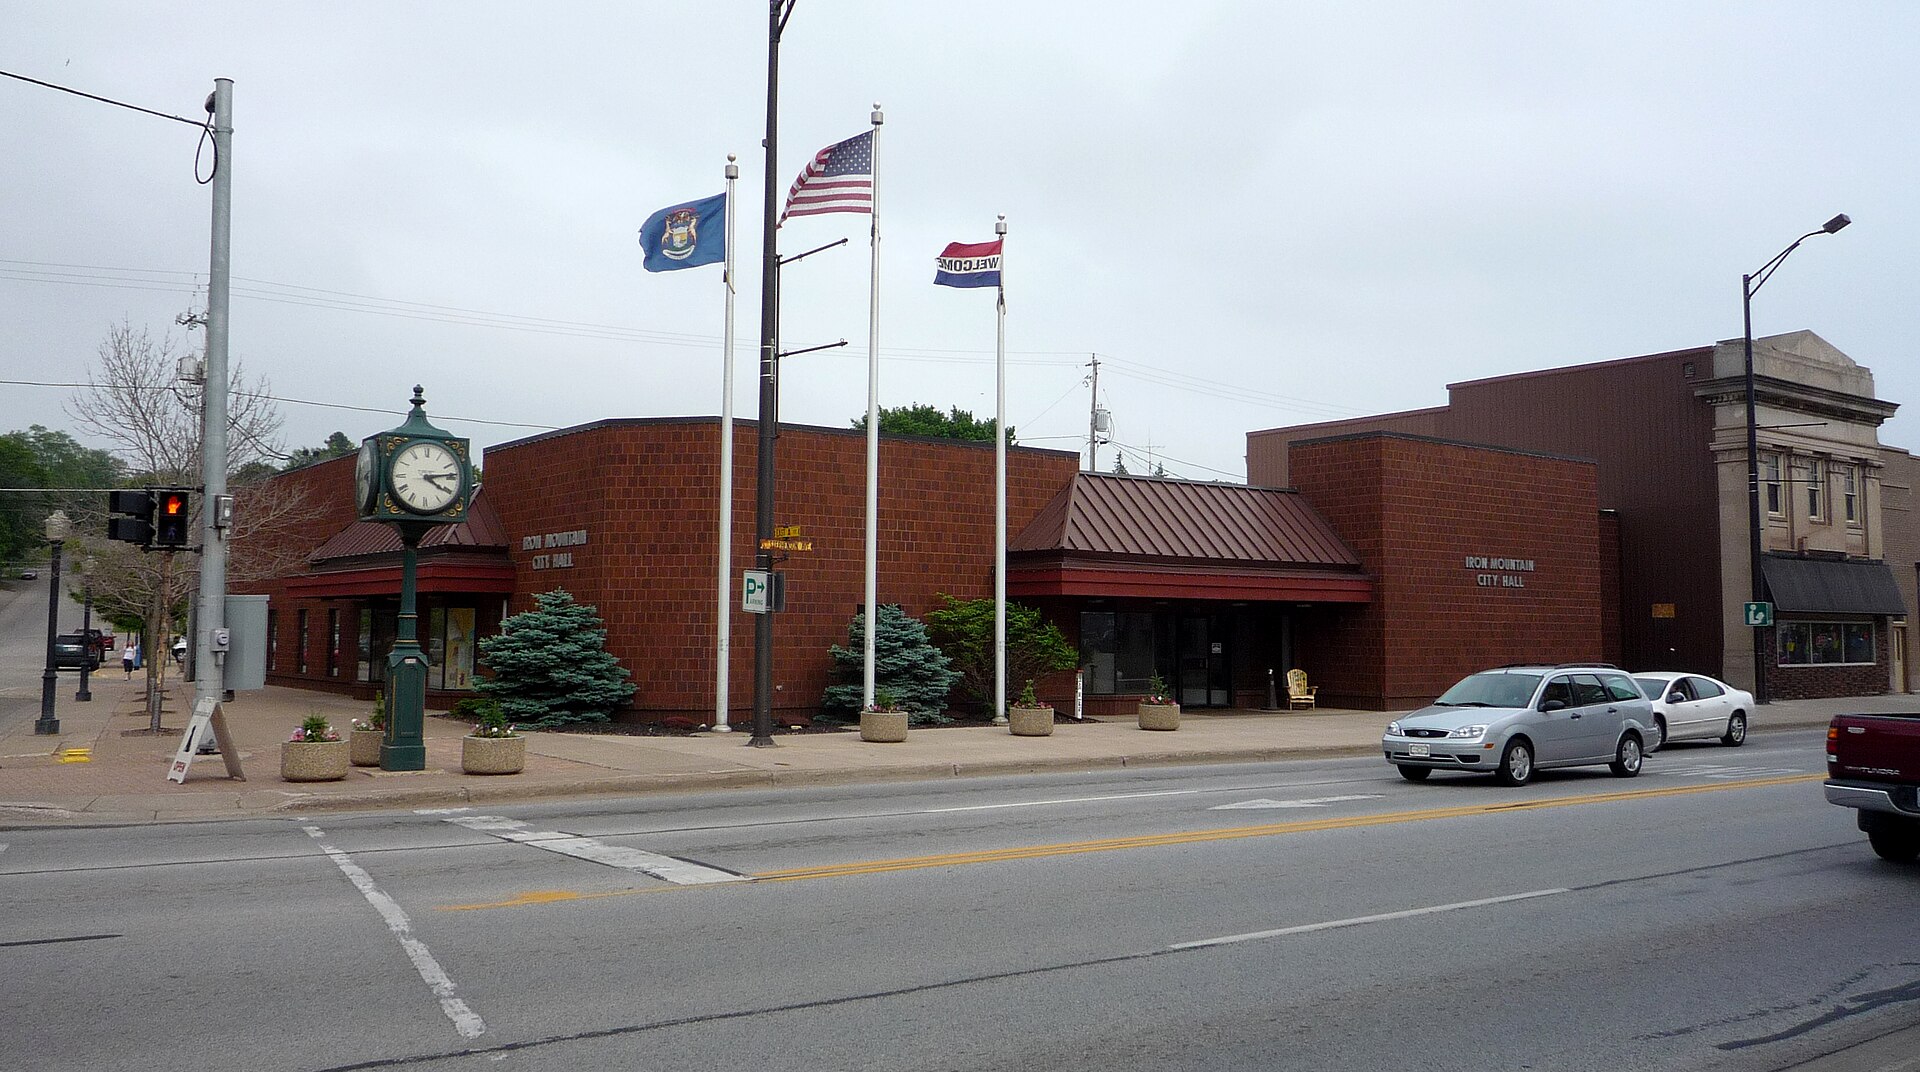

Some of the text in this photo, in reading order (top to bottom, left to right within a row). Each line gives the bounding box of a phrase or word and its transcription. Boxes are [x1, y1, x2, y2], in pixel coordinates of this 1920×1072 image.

[523, 530, 587, 550] IRON MOUNTAIN
[532, 553, 574, 570] CITY HALL
[1465, 556, 1534, 571] IRON MOUNTAIN
[1477, 574, 1524, 588] CITY HALL
